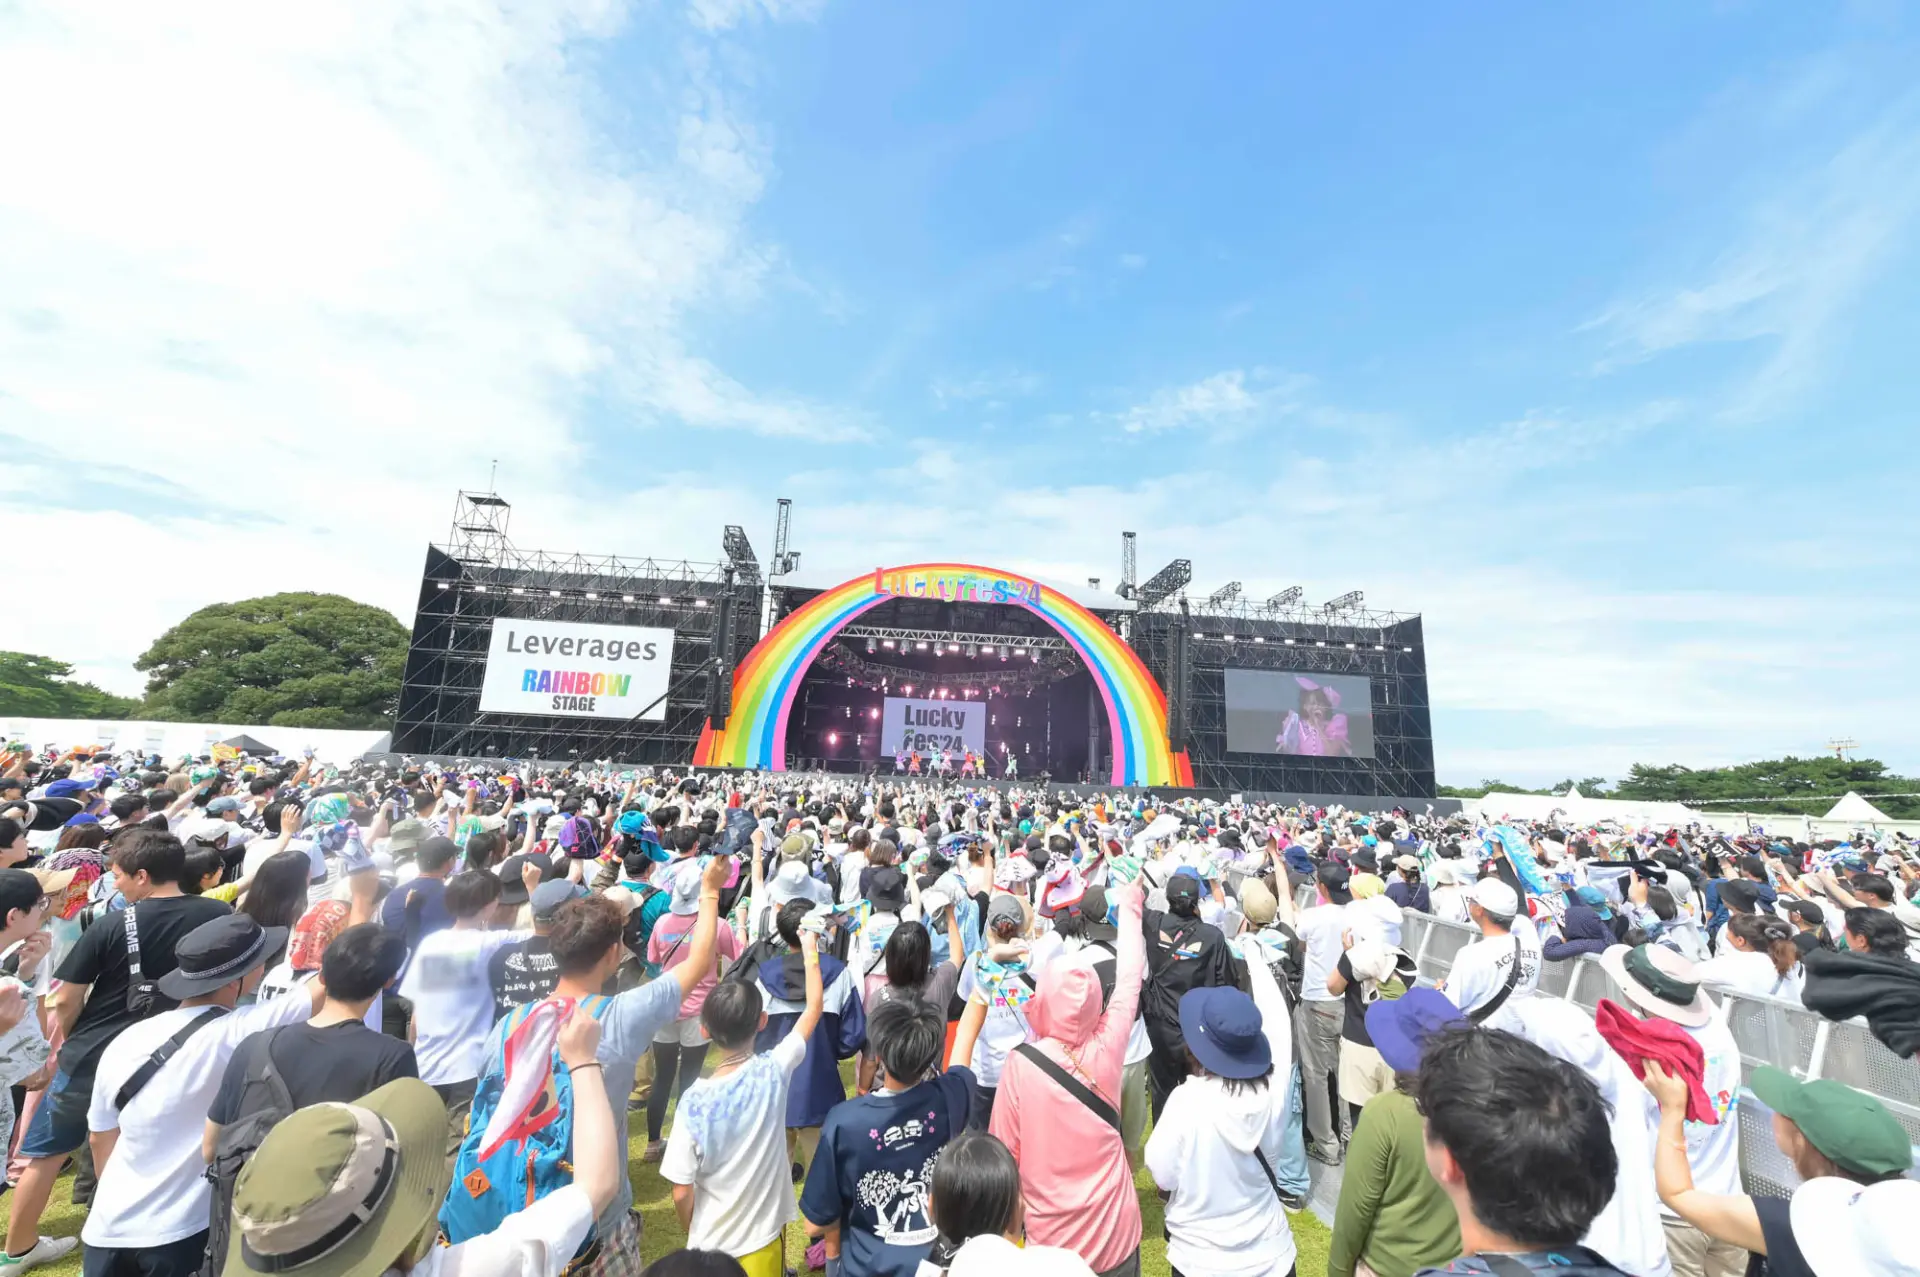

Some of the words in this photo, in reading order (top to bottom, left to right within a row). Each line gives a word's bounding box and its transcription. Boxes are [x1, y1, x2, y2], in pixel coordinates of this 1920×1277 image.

[507, 631, 657, 661] Leverages
[521, 668, 631, 697] RAINBOW
[552, 695, 596, 712] STAGE
[904, 705, 966, 730] Lucky
[124, 905, 139, 953] PREME
